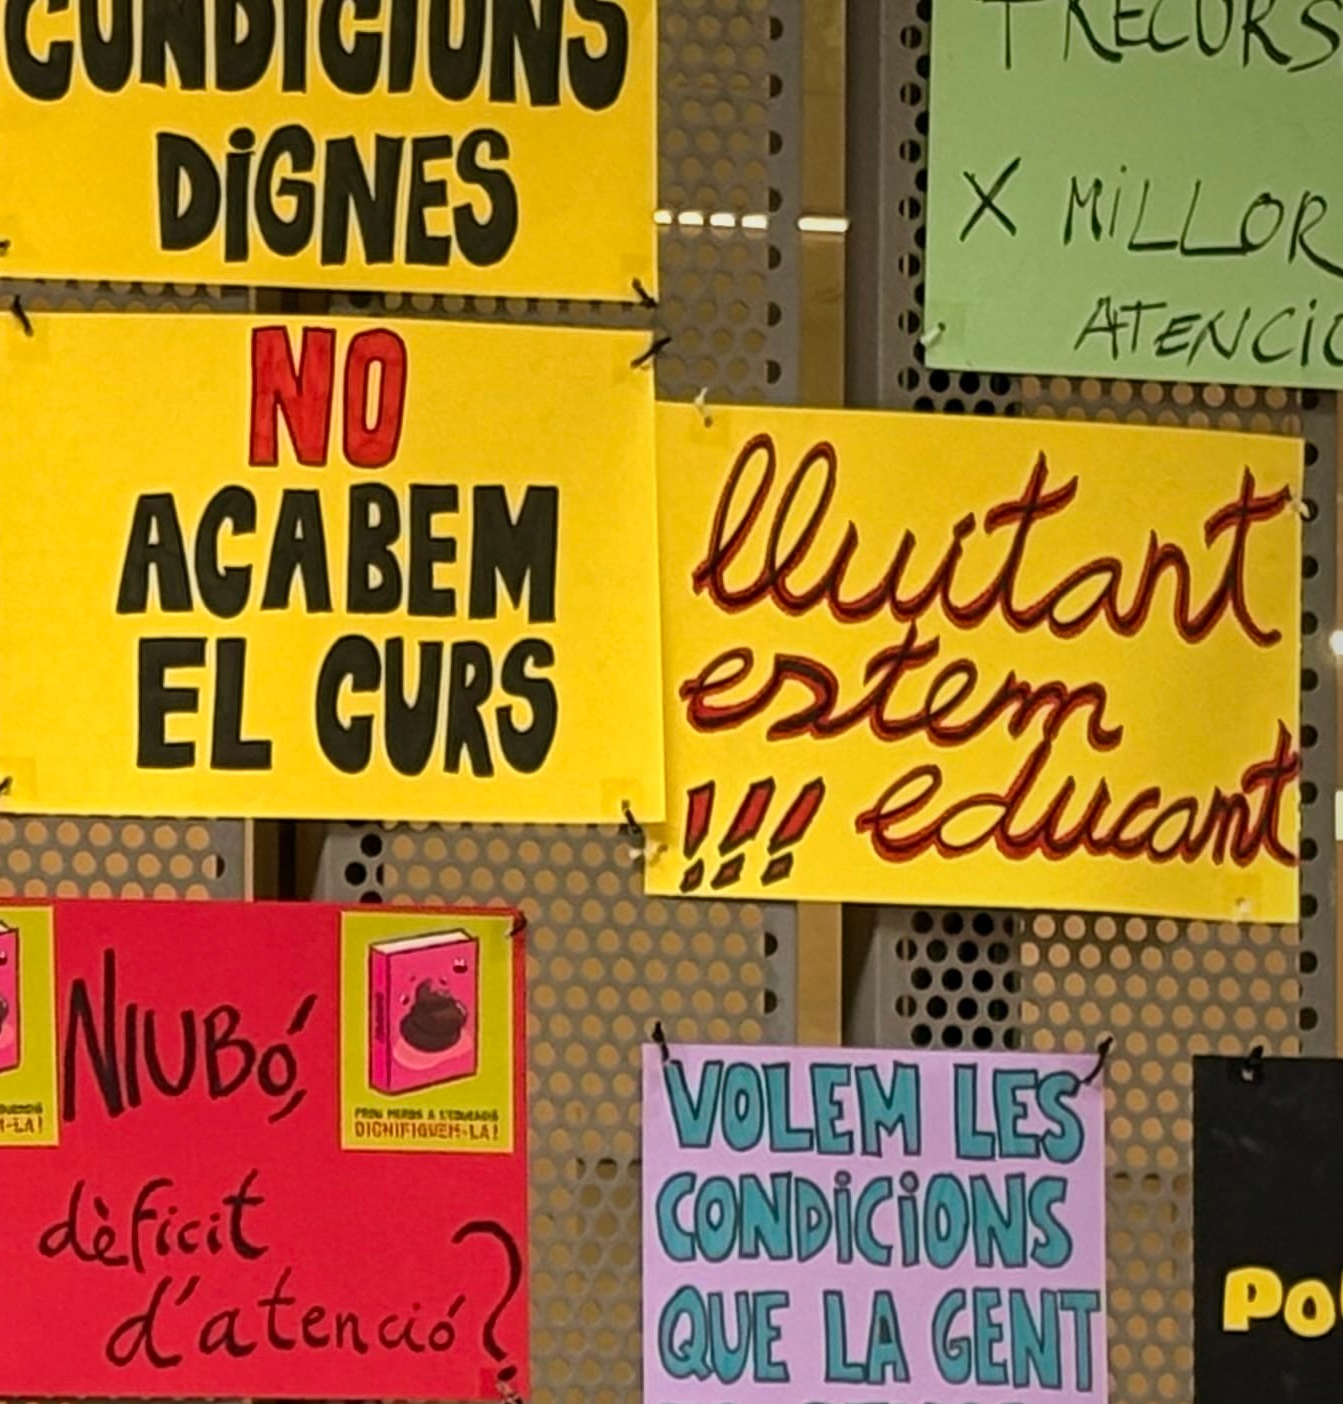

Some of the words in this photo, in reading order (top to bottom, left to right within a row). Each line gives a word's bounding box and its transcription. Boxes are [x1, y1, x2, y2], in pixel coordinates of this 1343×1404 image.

[4, 0, 629, 111] CONDICIONS
[960, 157, 1021, 241] X
[249, 326, 408, 468] NO
[116, 482, 559, 624] ACABEM
[693, 433, 1289, 646] lluitant
[137, 636, 272, 771] EL
[316, 634, 559, 778] CURS
[680, 618, 1123, 751] estem
[856, 720, 1301, 867] educant
[662, 1060, 920, 1159] VOLEM
[953, 1062, 1083, 1163] LES
[38, 1168, 270, 1273] dèficit
[658, 1285, 790, 1384] QUE
[823, 1290, 910, 1384] LA
[931, 1288, 1101, 1392] GENT
[1222, 1265, 1343, 1338] Po
